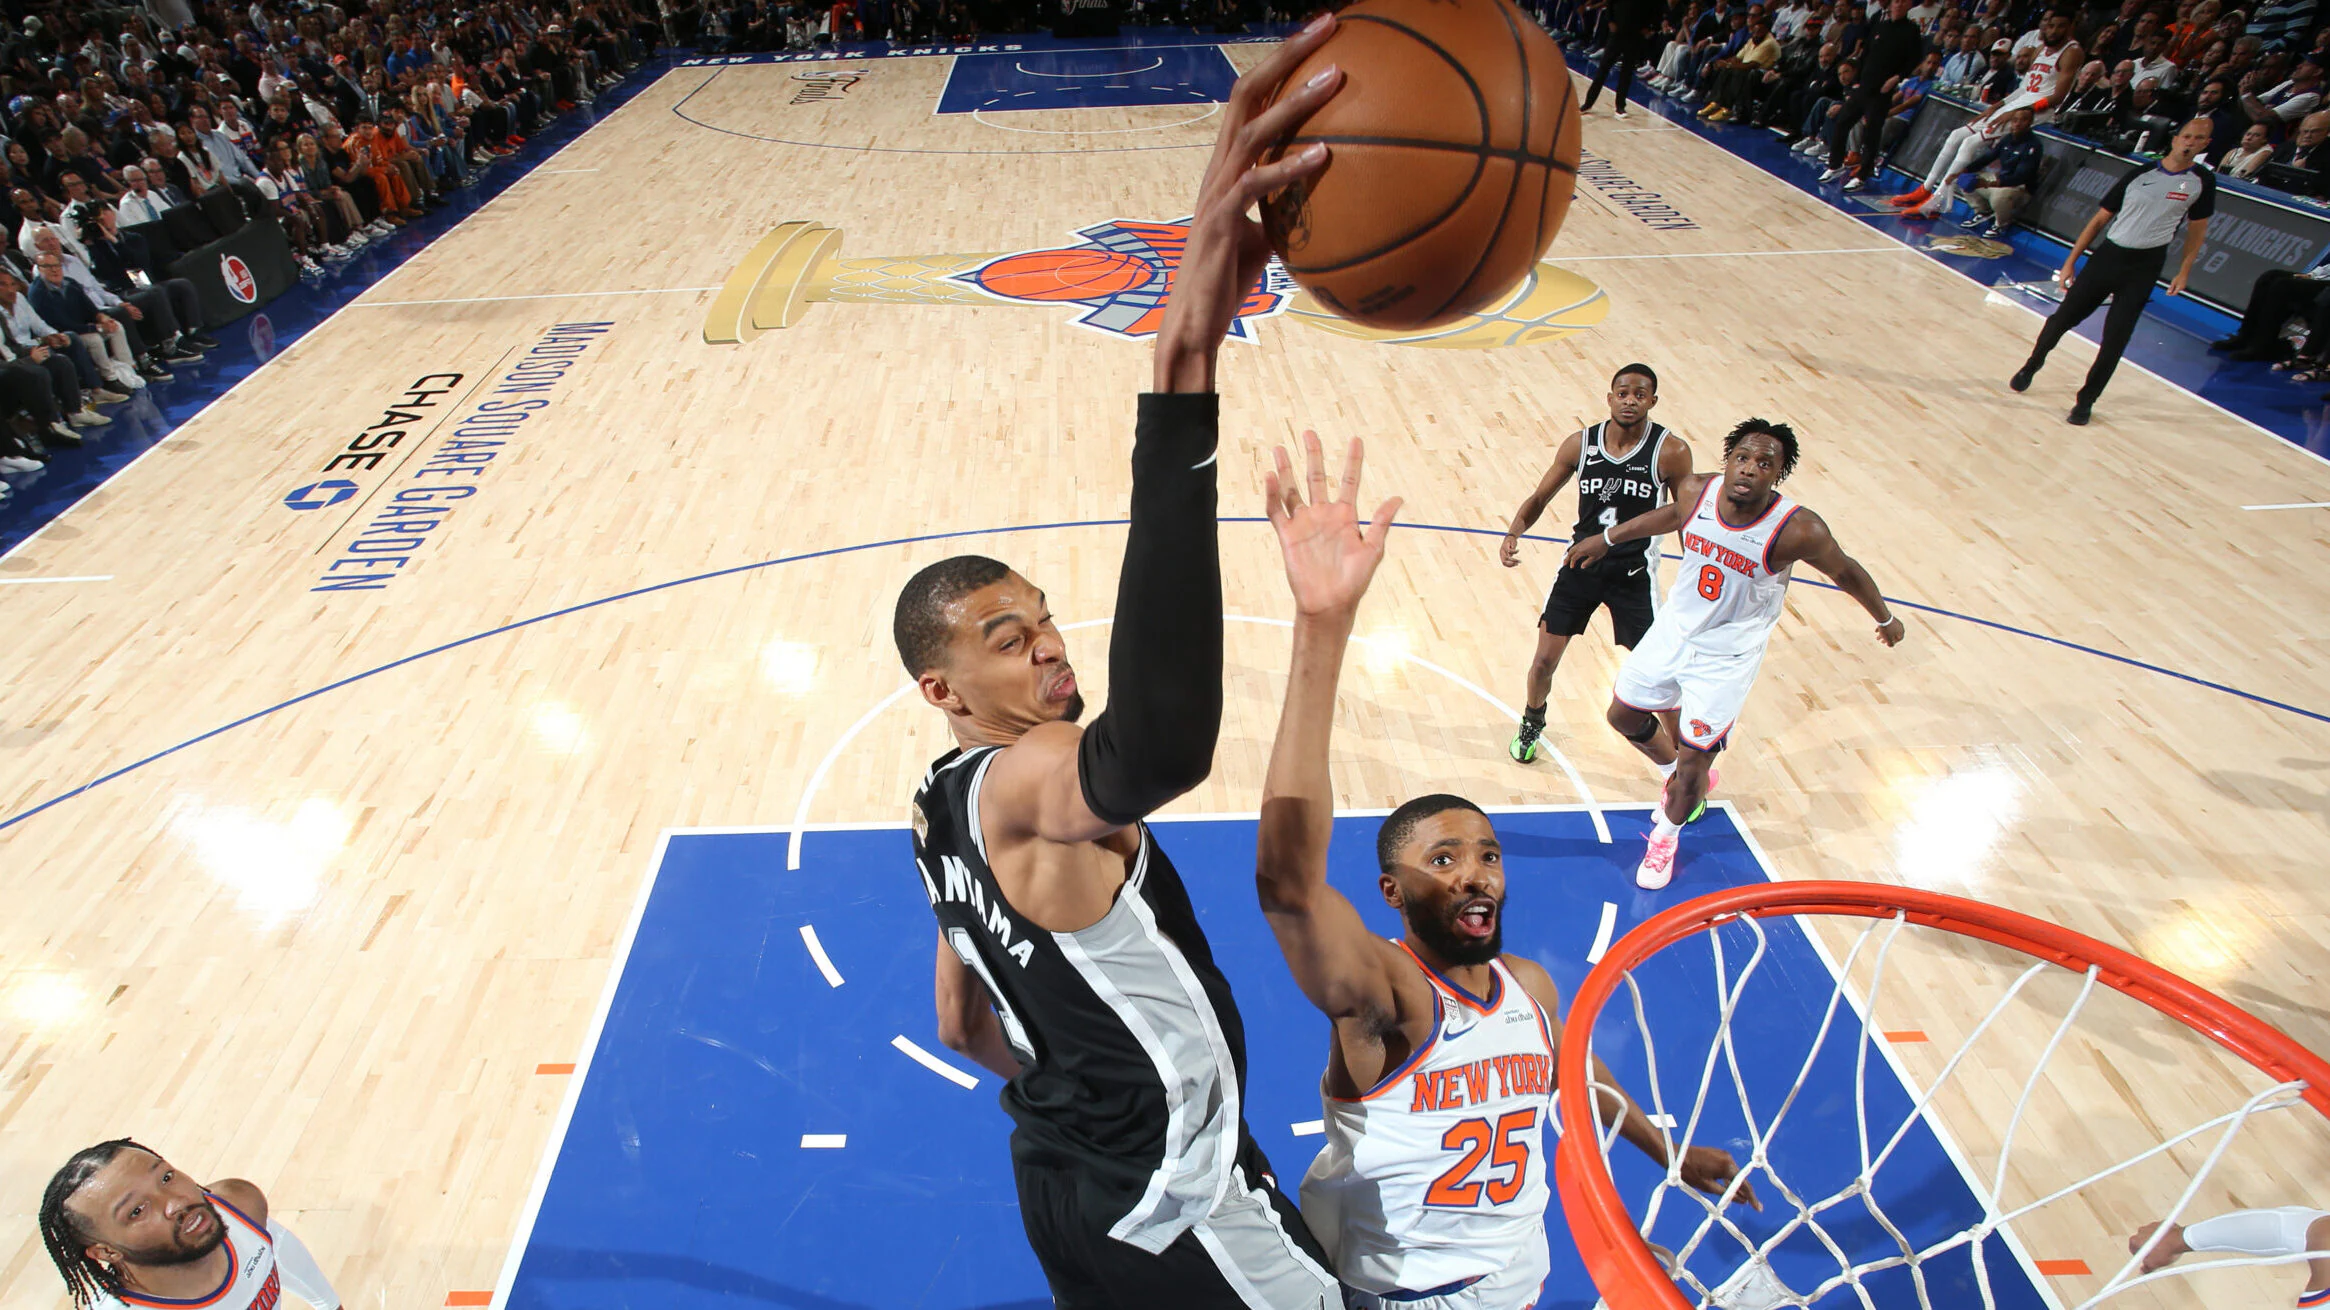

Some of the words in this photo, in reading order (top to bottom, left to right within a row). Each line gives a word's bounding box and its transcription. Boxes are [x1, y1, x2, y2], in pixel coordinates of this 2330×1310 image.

[682, 56, 752, 65] NEW
[773, 50, 865, 62] YORK
[887, 45, 1022, 56] KNICKS
[2026, 73, 2043, 92] 32
[1607, 192, 1702, 230] GARDEN
[2224, 218, 2313, 266] KNIGHTS
[492, 321, 615, 394] MADISON
[322, 373, 464, 472] CHASE
[414, 399, 550, 478] SQUARE
[309, 486, 477, 592] GARDEN
[1599, 507, 1618, 528] 4
[1684, 531, 1717, 558] NEW
[1715, 544, 1759, 578] YORK
[1697, 564, 1725, 602] 8
[948, 927, 1037, 1060] 1
[1410, 1056, 1490, 1112] NEW
[1492, 1053, 1550, 1098] YORK
[1423, 1106, 1538, 1208] 25
